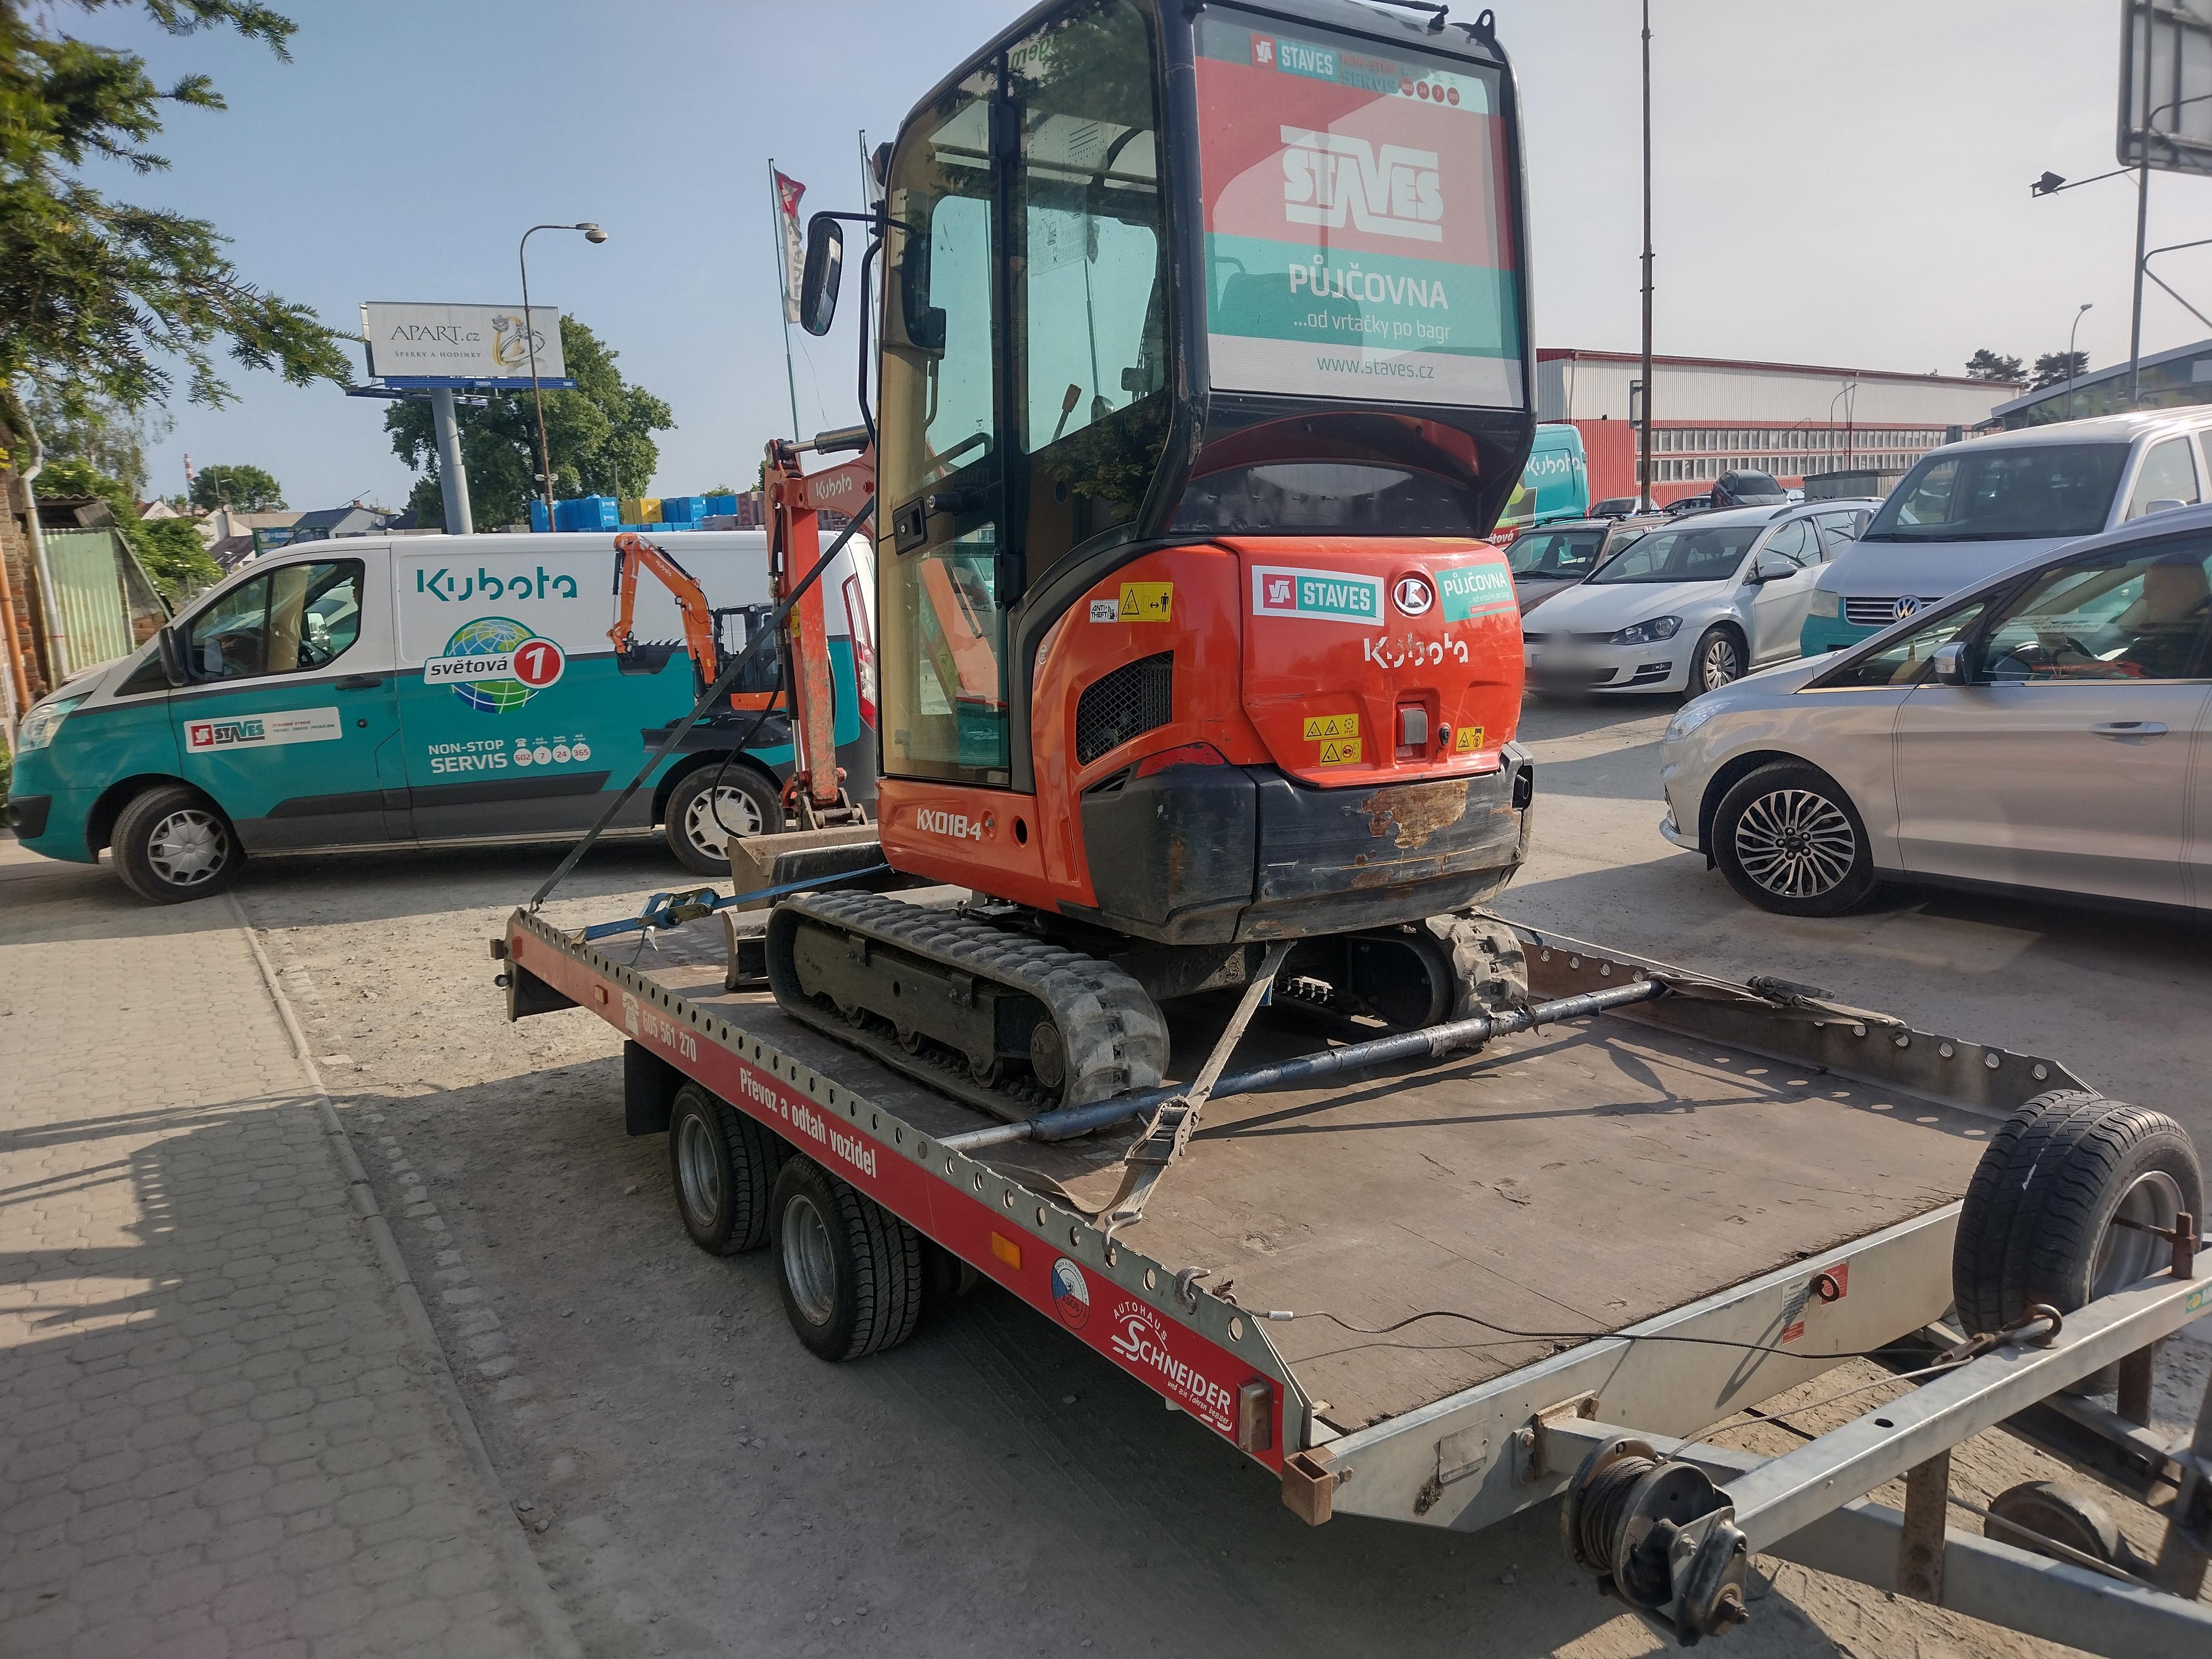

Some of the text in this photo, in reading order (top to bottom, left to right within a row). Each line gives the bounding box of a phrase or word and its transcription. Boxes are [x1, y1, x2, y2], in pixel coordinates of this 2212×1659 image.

[1281, 45, 1333, 75] STAVES
[1341, 69, 1398, 93] SERVIS
[1280, 124, 1443, 242] STAVES
[1289, 254, 1449, 310] PŮJČOVNA
[390, 325, 480, 345] APART.cz
[1332, 315, 1389, 337] vrtačky
[1394, 322, 1412, 340] po
[1417, 323, 1450, 343] bagr
[1317, 357, 1434, 379] www.staves.cz
[1526, 452, 1580, 476] Kubota
[816, 473, 852, 499] Kubota
[417, 566, 577, 601] Kubota
[1304, 582, 1370, 611] STAVES
[1443, 572, 1507, 597] PŮJČOVNA
[431, 648, 545, 679] světová 1
[1364, 632, 1468, 668] Kubota
[213, 719, 265, 744] STAVES
[428, 740, 504, 755] NON-STOP
[431, 753, 508, 774] SERVIS
[917, 808, 982, 841] KX018-4
[642, 1009, 697, 1062] 605 561 270
[739, 1066, 877, 1179] Převoz a odtah vozidel
[1062, 1295, 1079, 1312] ASOS
[1114, 1302, 1167, 1340] AUTOHAUS
[1111, 1321, 1230, 1415] SCHNEIDER
[1167, 1381, 1178, 1391] und
[1189, 1394, 1207, 1411] fahren
[1209, 1406, 1229, 1425] besser
